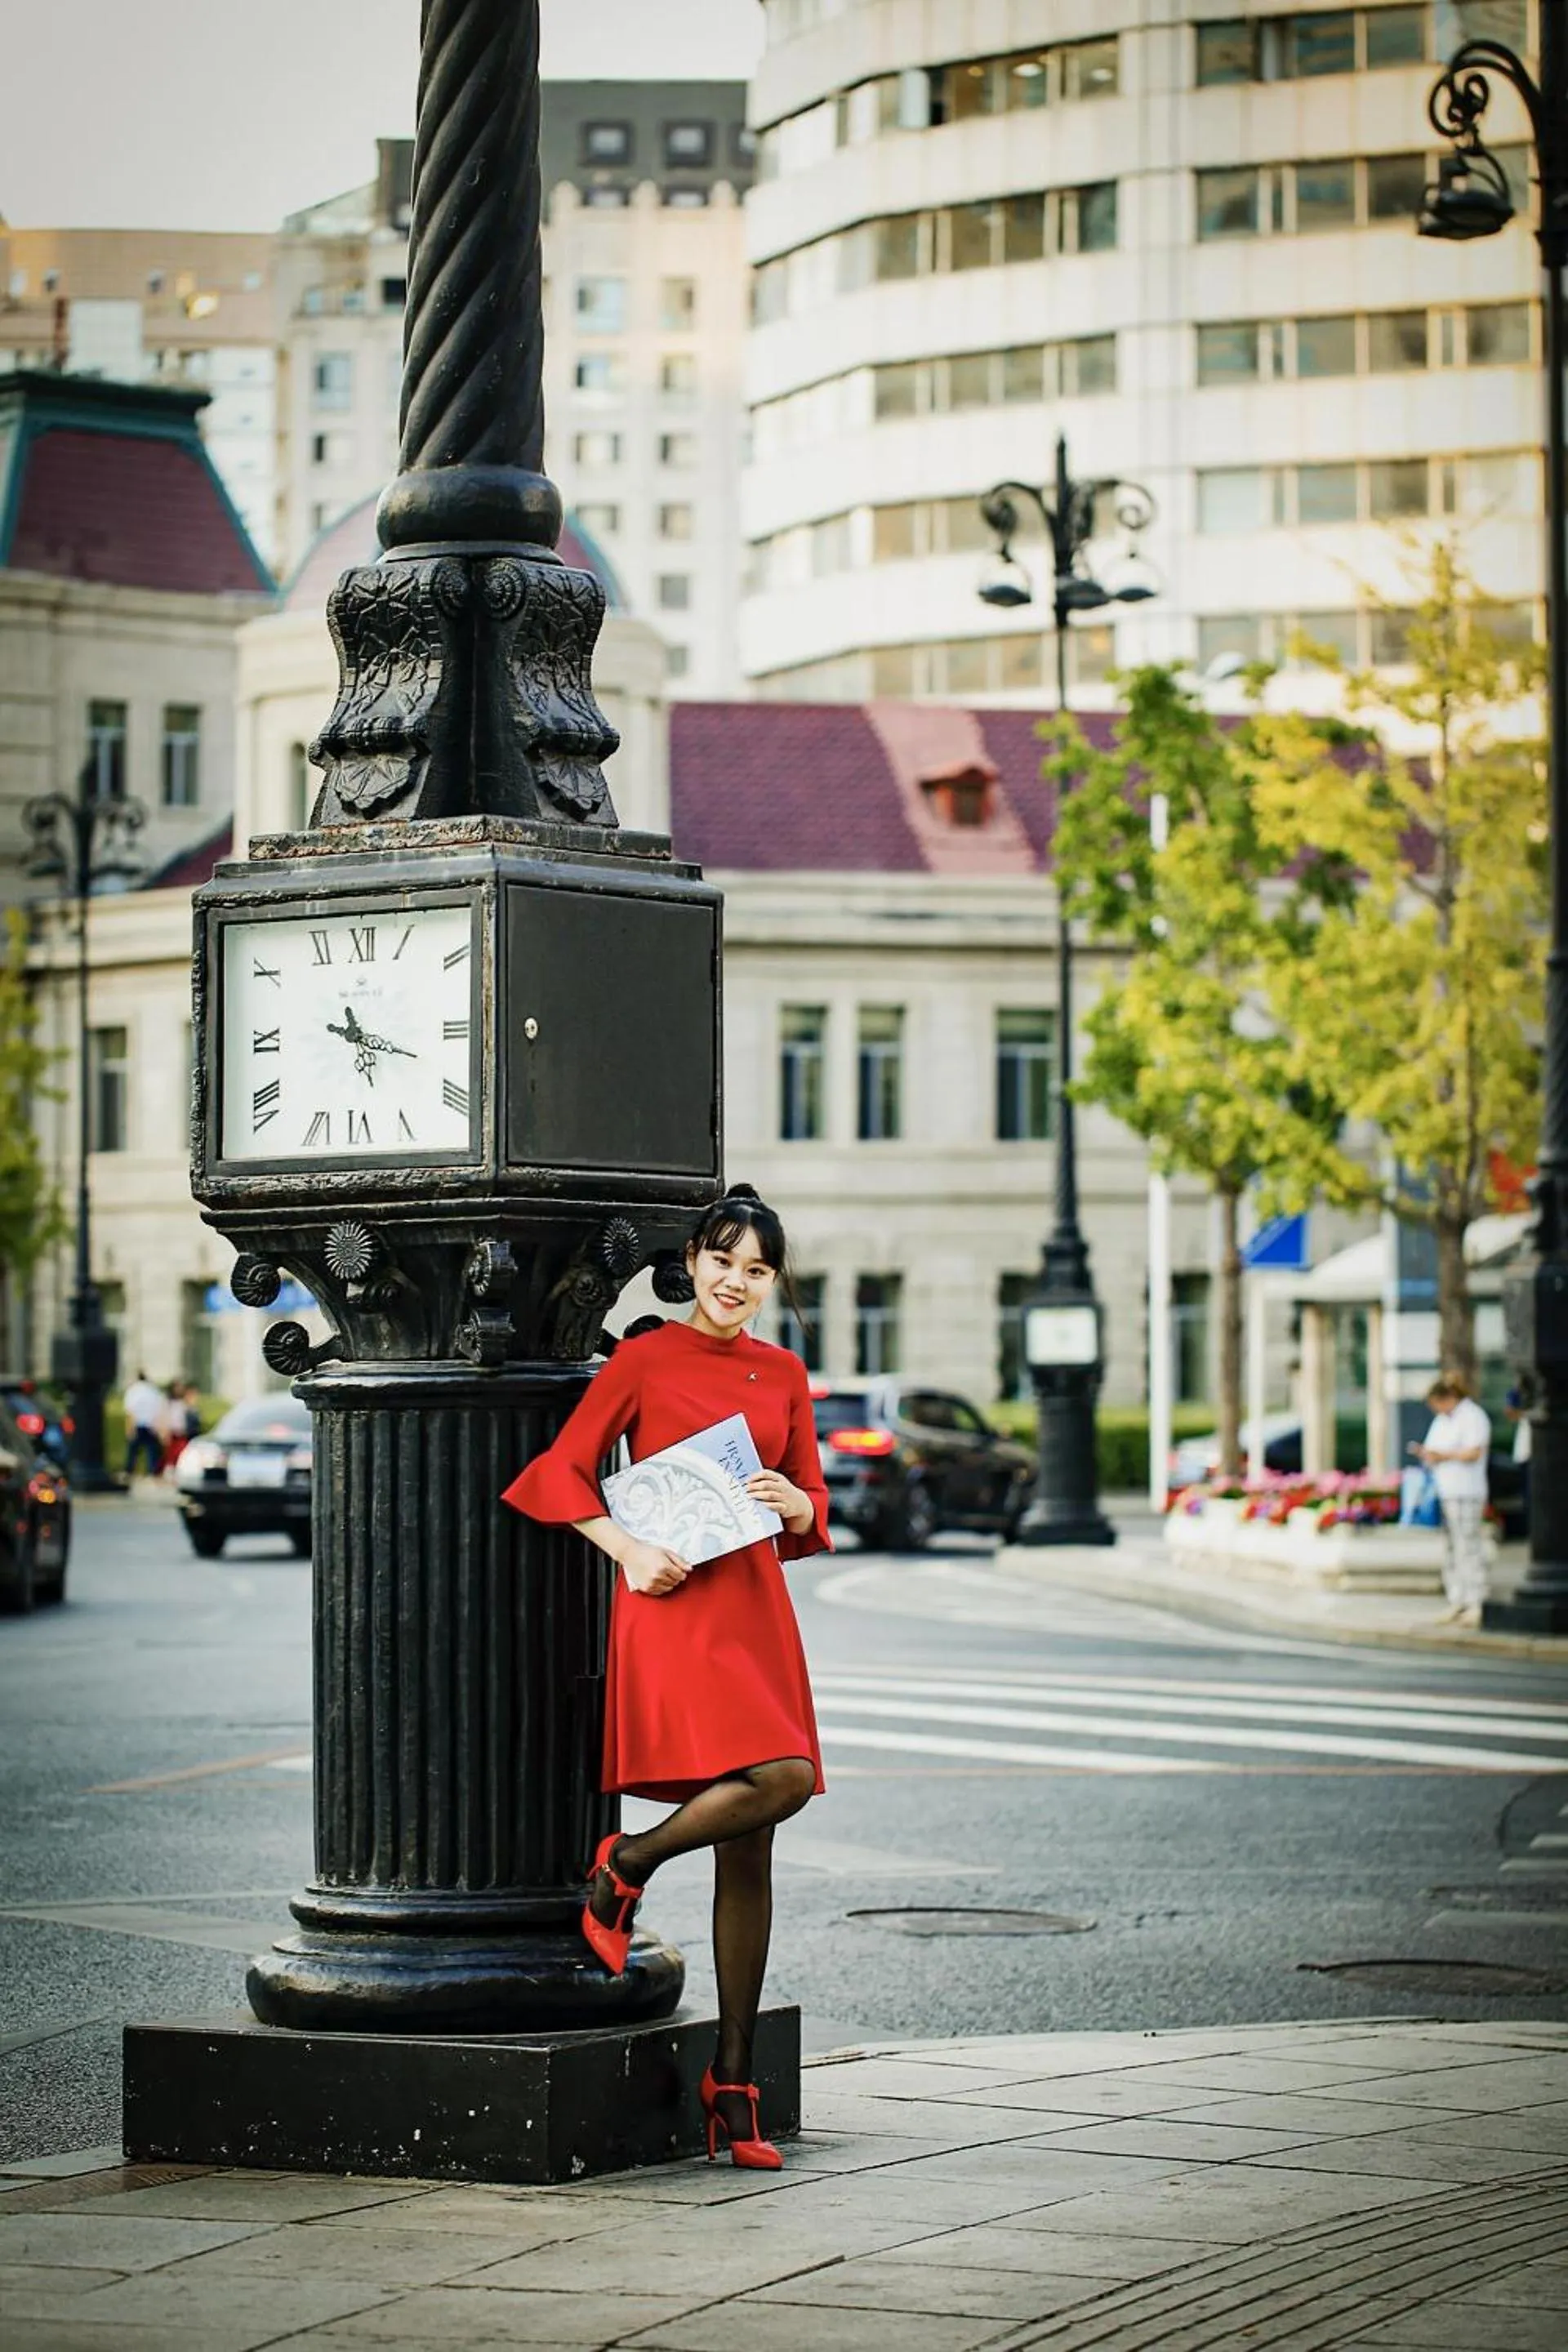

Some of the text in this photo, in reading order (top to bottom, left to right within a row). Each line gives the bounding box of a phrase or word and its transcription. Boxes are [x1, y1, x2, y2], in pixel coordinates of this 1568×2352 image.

[348, 926, 376, 962] XII
[253, 957, 281, 988] X
[253, 1027, 280, 1054] IX
